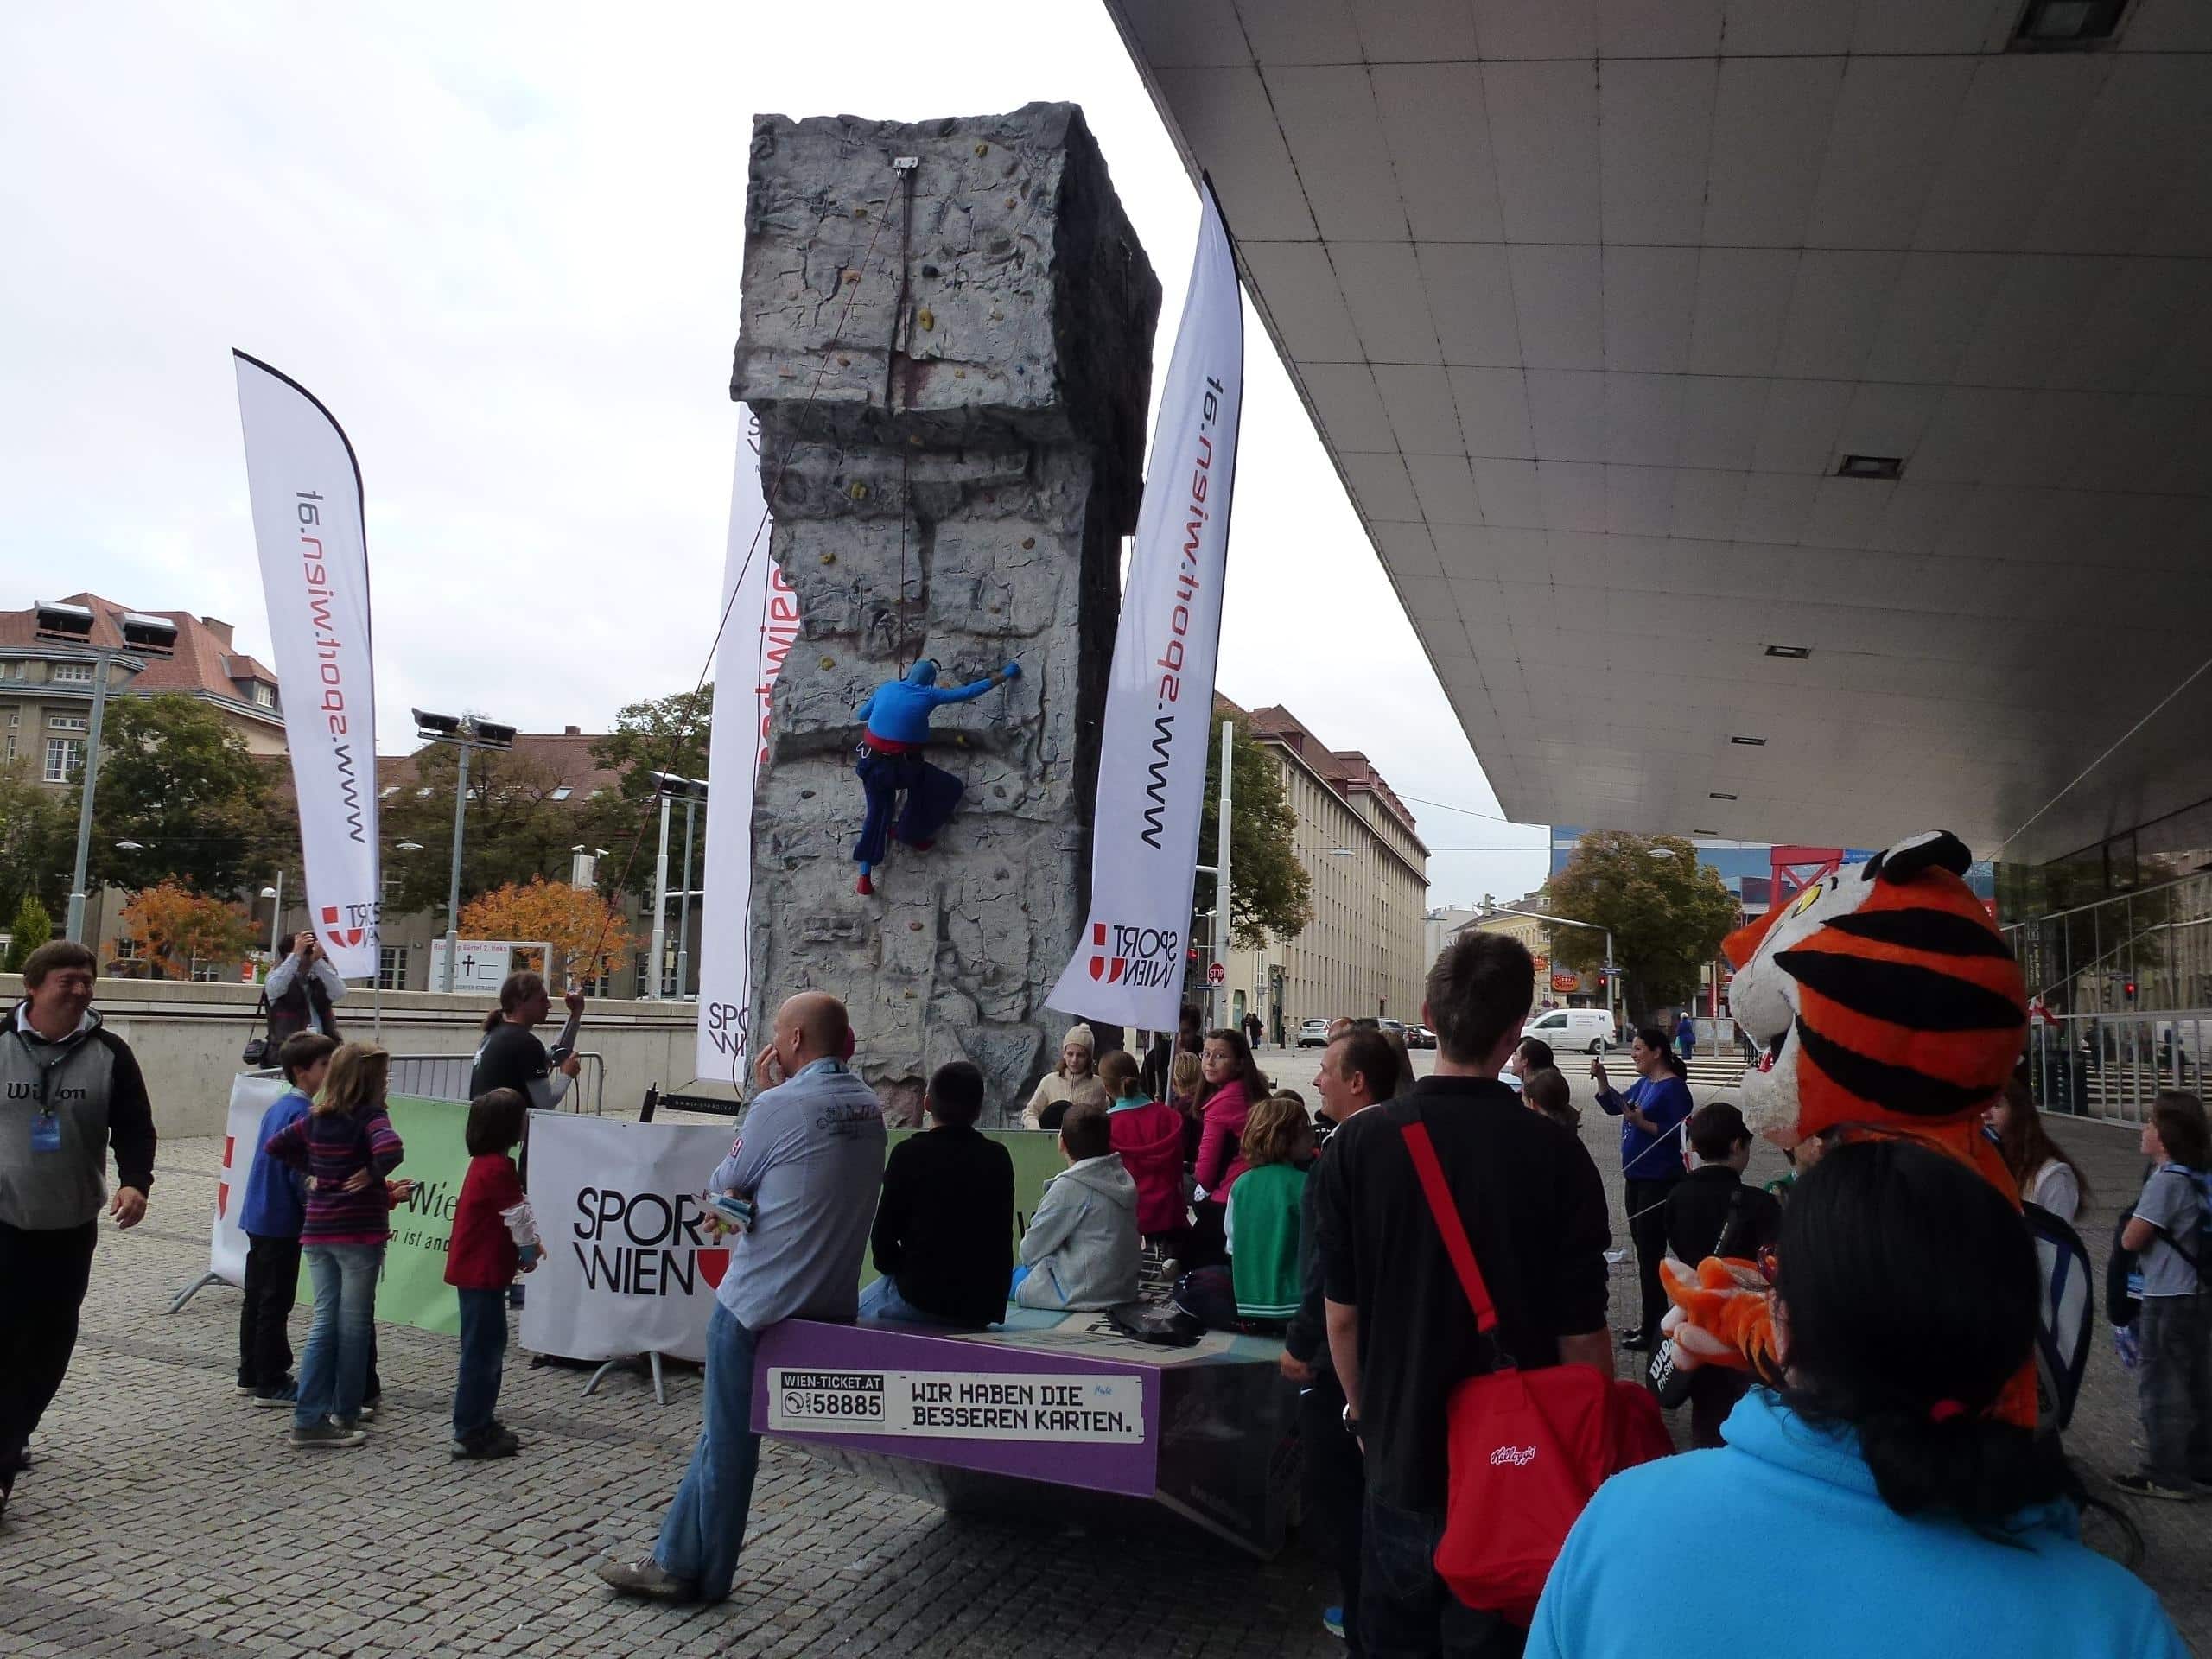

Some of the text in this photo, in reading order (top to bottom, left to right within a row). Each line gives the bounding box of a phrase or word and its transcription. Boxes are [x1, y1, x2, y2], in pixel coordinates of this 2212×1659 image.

[1209, 969, 1224, 978] STOP
[7, 1082, 86, 1100] Wion
[574, 1186, 721, 1246] SPOR
[572, 1242, 696, 1296] WIEN
[784, 1375, 881, 1389] WIEN-TICKET.AT
[813, 1393, 881, 1415] 58885
[912, 1382, 952, 1403] WIR
[960, 1383, 1033, 1406] HABEN
[1040, 1386, 1083, 1407] DIE
[912, 1406, 1132, 1433] BESSEREN KARTEN.
[1491, 1446, 1535, 1465] Kellogg's
